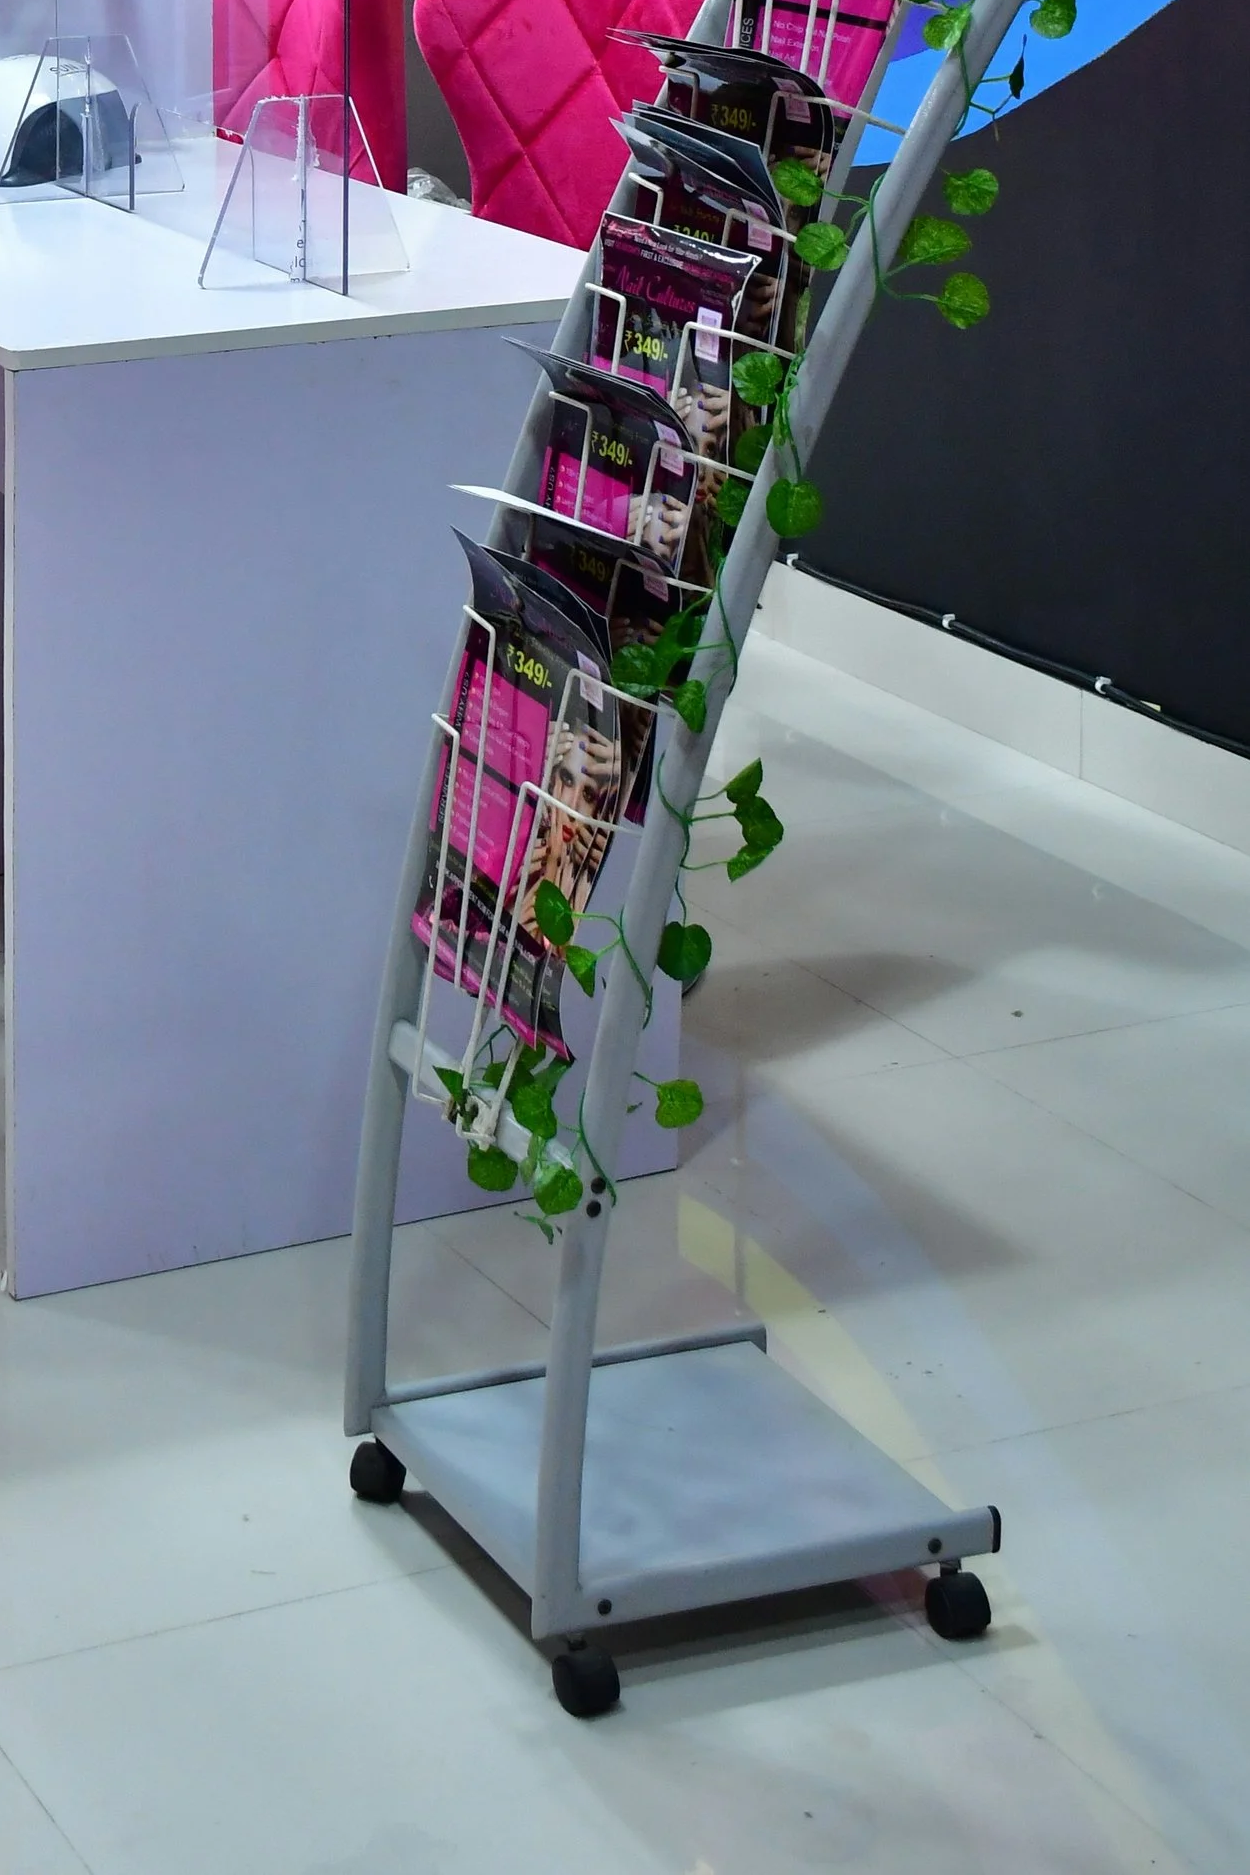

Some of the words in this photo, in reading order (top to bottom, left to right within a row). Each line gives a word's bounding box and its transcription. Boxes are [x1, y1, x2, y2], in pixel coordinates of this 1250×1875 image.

[624, 330, 668, 362] ₹349/-
[592, 431, 633, 467] ₹349/-
[506, 642, 552, 689] ₹349/-
